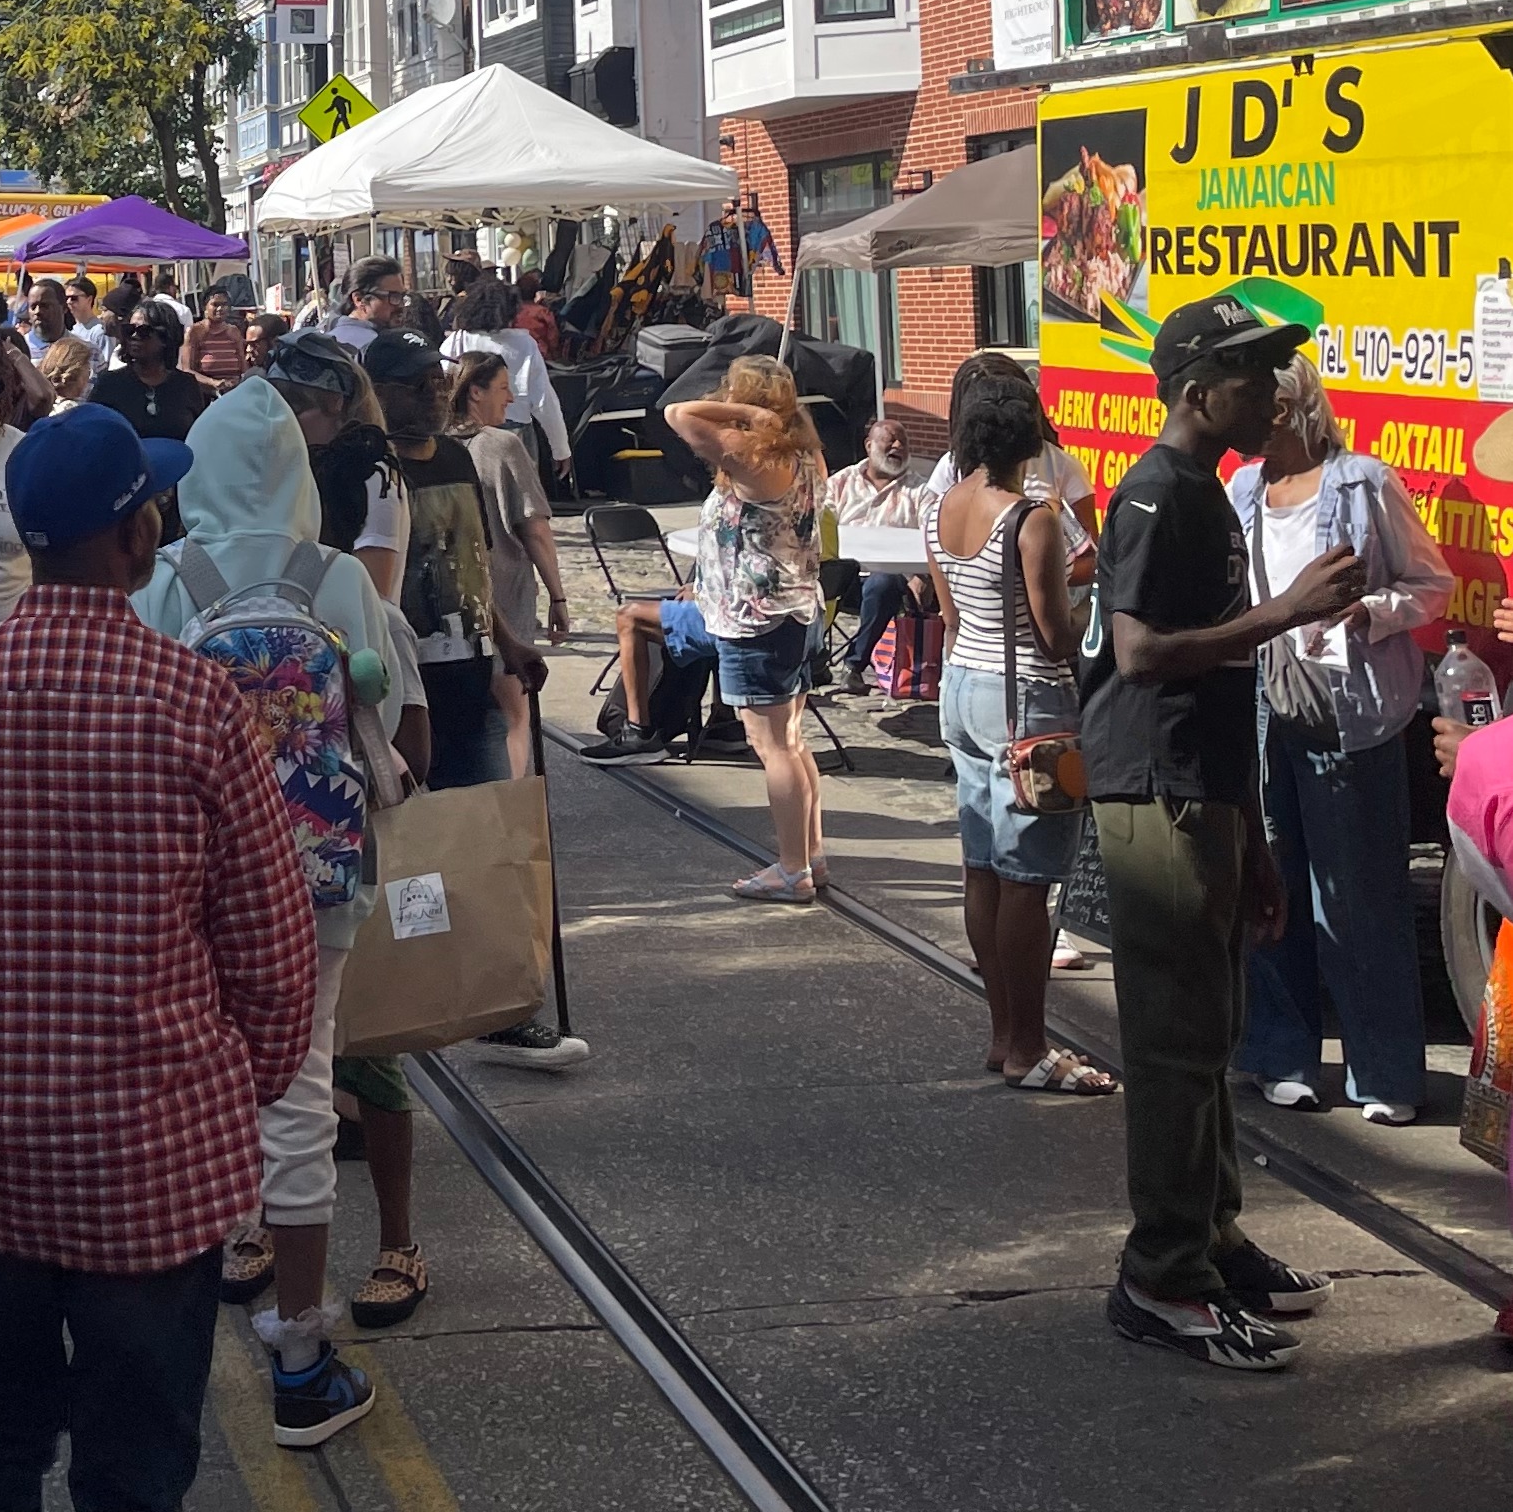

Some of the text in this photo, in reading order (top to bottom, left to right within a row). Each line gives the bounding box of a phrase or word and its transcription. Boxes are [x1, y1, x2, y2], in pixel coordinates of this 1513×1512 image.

[1004, 0, 1050, 20] RIGHTEOUS
[39, 204, 49, 217] &
[1197, 160, 1335, 211] JAMAICAN
[1150, 220, 1460, 277] RESTAURANT
[1354, 330, 1475, 382] 410-921-5
[1414, 496, 1513, 557] ATTIES
